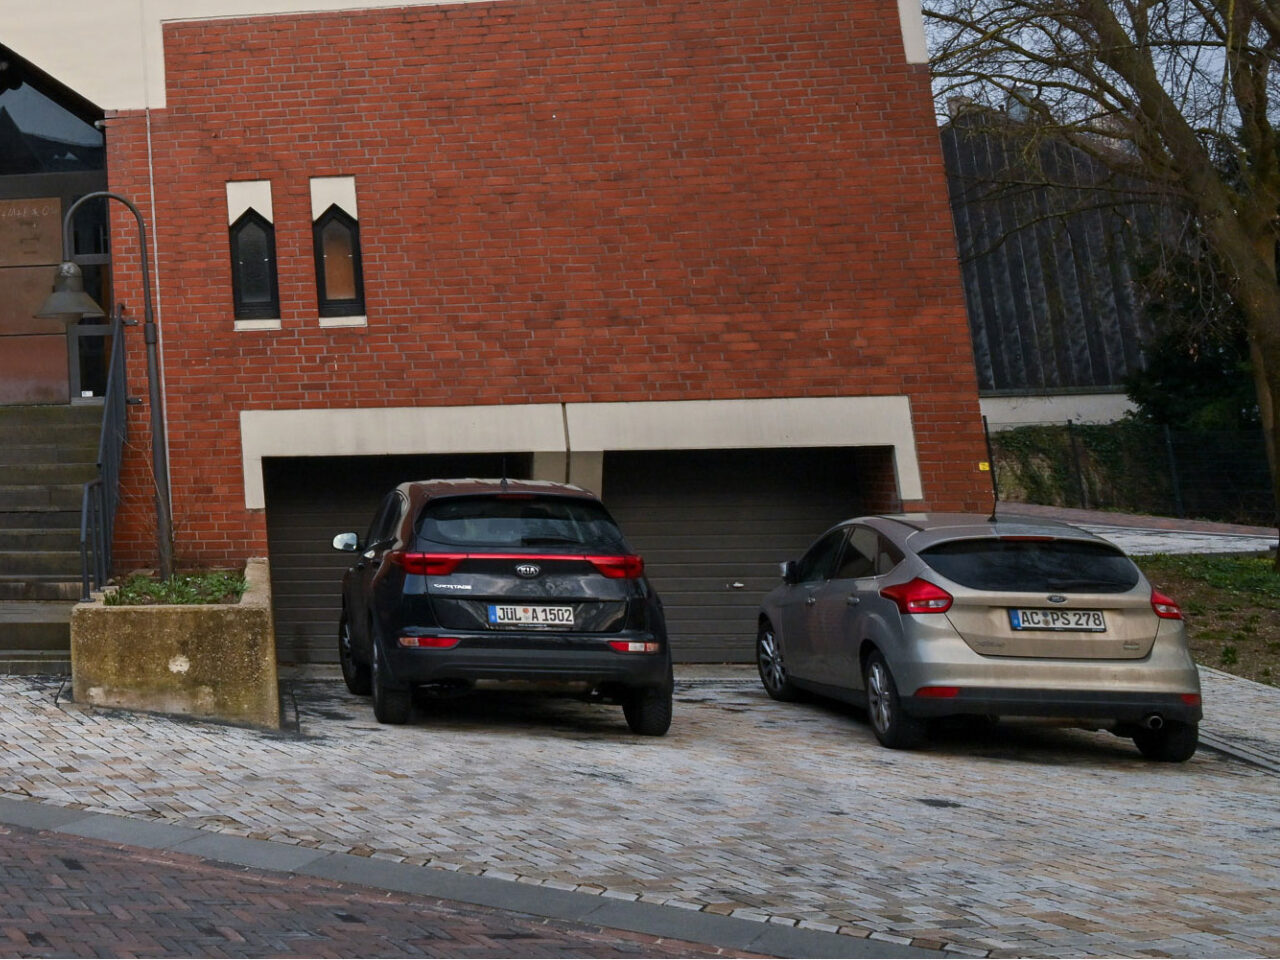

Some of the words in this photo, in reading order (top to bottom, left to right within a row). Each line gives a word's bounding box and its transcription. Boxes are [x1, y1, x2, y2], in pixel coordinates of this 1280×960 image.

[521, 566, 536, 575] KIA
[531, 608, 539, 622] A
[541, 608, 572, 623] 1502
[1021, 611, 1040, 625] AC
[1050, 611, 1071, 626] PS
[1073, 612, 1102, 627] 278
